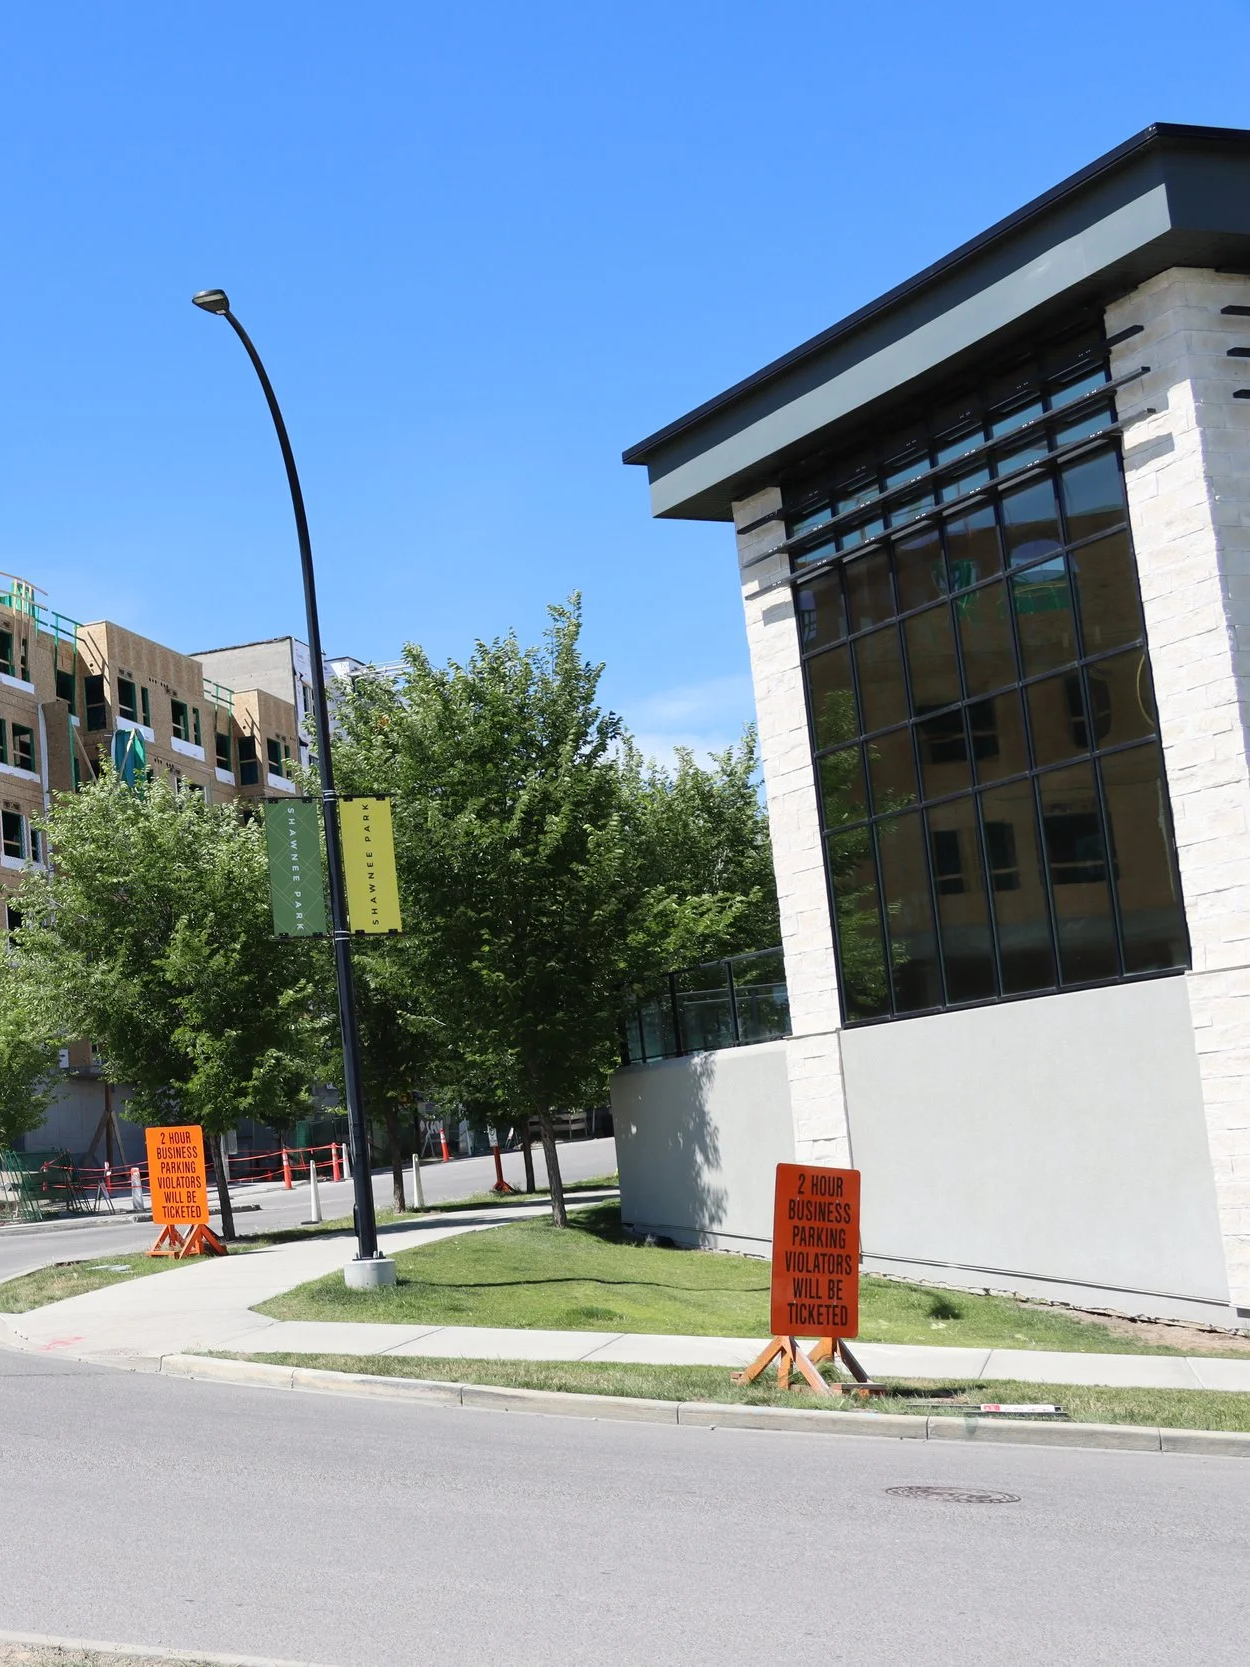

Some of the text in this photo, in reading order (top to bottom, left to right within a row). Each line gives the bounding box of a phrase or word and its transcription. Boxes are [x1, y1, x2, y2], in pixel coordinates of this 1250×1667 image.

[288, 808, 304, 930] SHAWNEE PARK
[362, 804, 379, 925] SHAWNEE PARK
[161, 1132, 191, 1144] 2 HOUR
[157, 1146, 197, 1159] BUSINESS
[161, 1161, 196, 1174] PARKING
[158, 1176, 201, 1189] VIOLATORS
[798, 1174, 843, 1197] 2 HOUR
[164, 1191, 196, 1203] WILL BE
[162, 1206, 201, 1218] TICKETED
[788, 1199, 850, 1224] BUSINESS
[792, 1225, 846, 1249] PARKING
[785, 1250, 852, 1275] VIOLATORS
[793, 1278, 843, 1300] WILL BE
[788, 1303, 848, 1326] TICKETED
